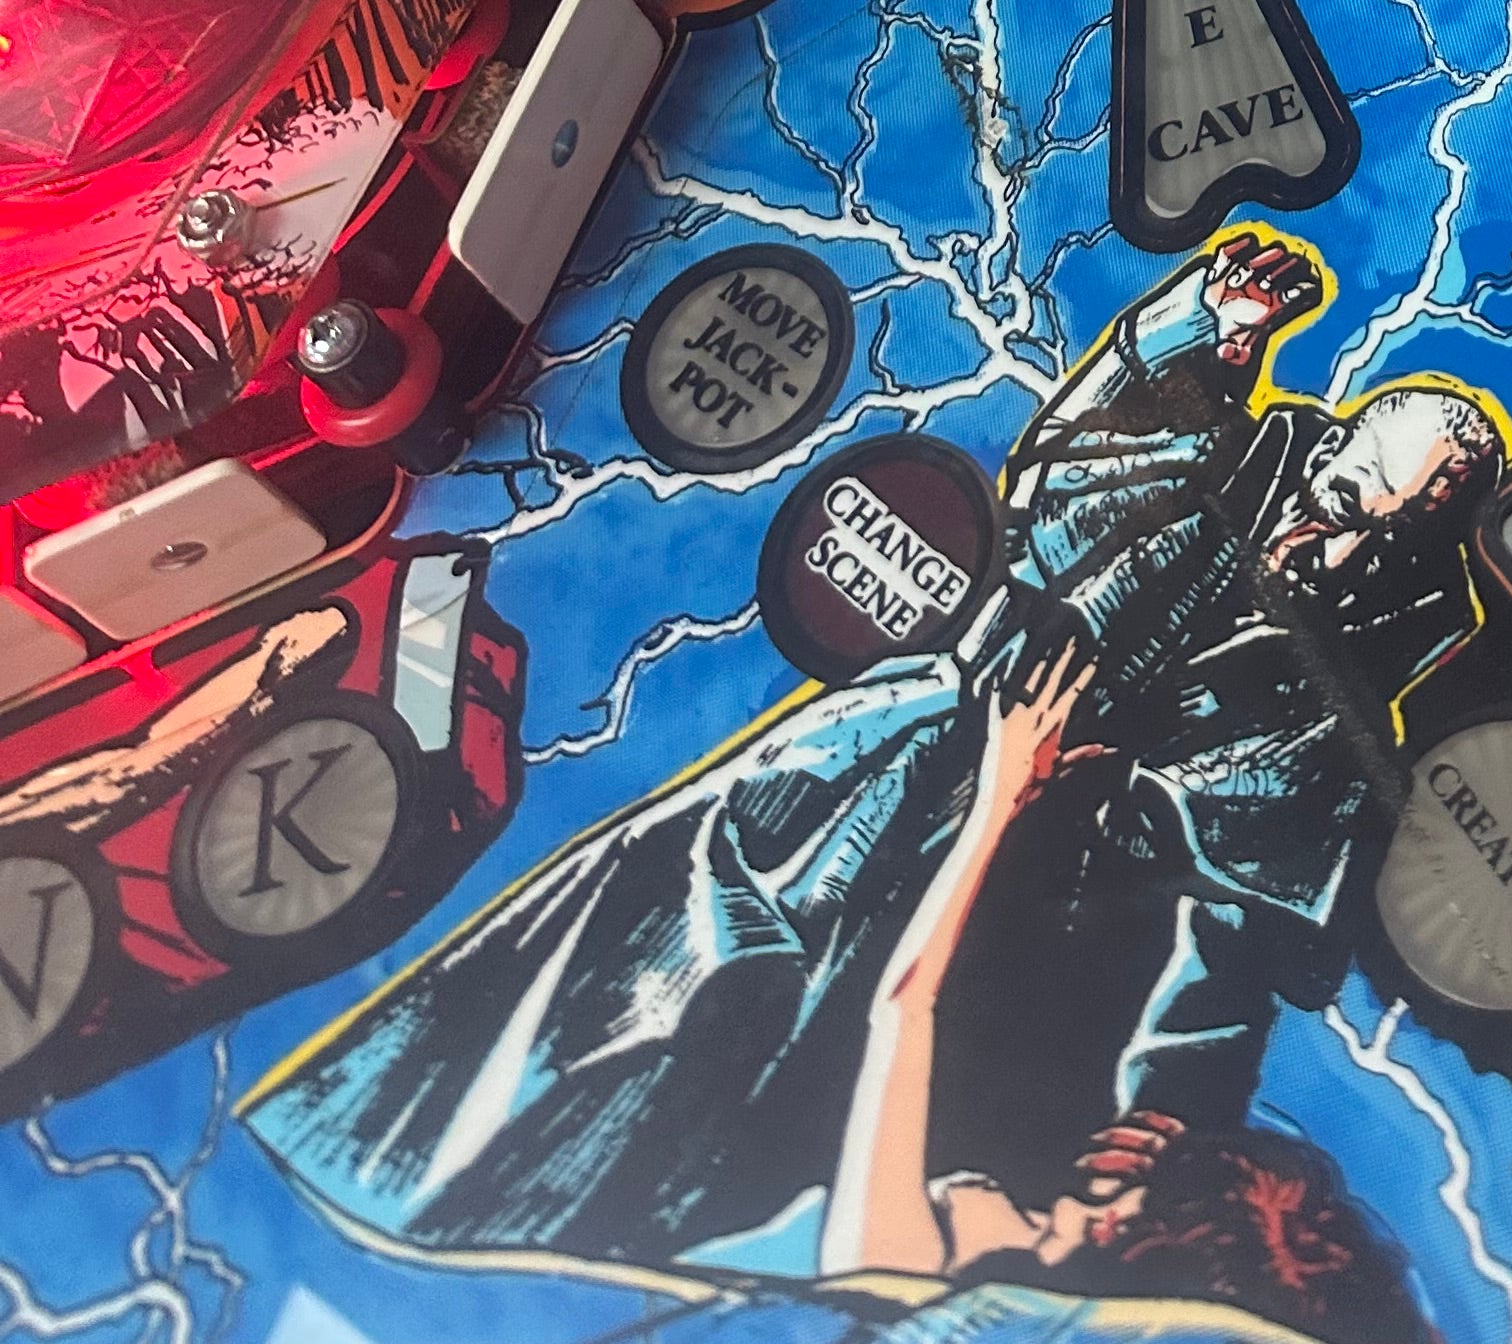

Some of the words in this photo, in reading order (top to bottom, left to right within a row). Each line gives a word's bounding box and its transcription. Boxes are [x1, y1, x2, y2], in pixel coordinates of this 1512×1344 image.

[1147, 83, 1304, 162] CAVE
[684, 313, 800, 400] JACK-
[717, 272, 827, 359] MOVE
[668, 366, 752, 429] POT
[807, 534, 923, 640] SCENE
[825, 478, 970, 610] CHANGE
[238, 742, 354, 898] K
